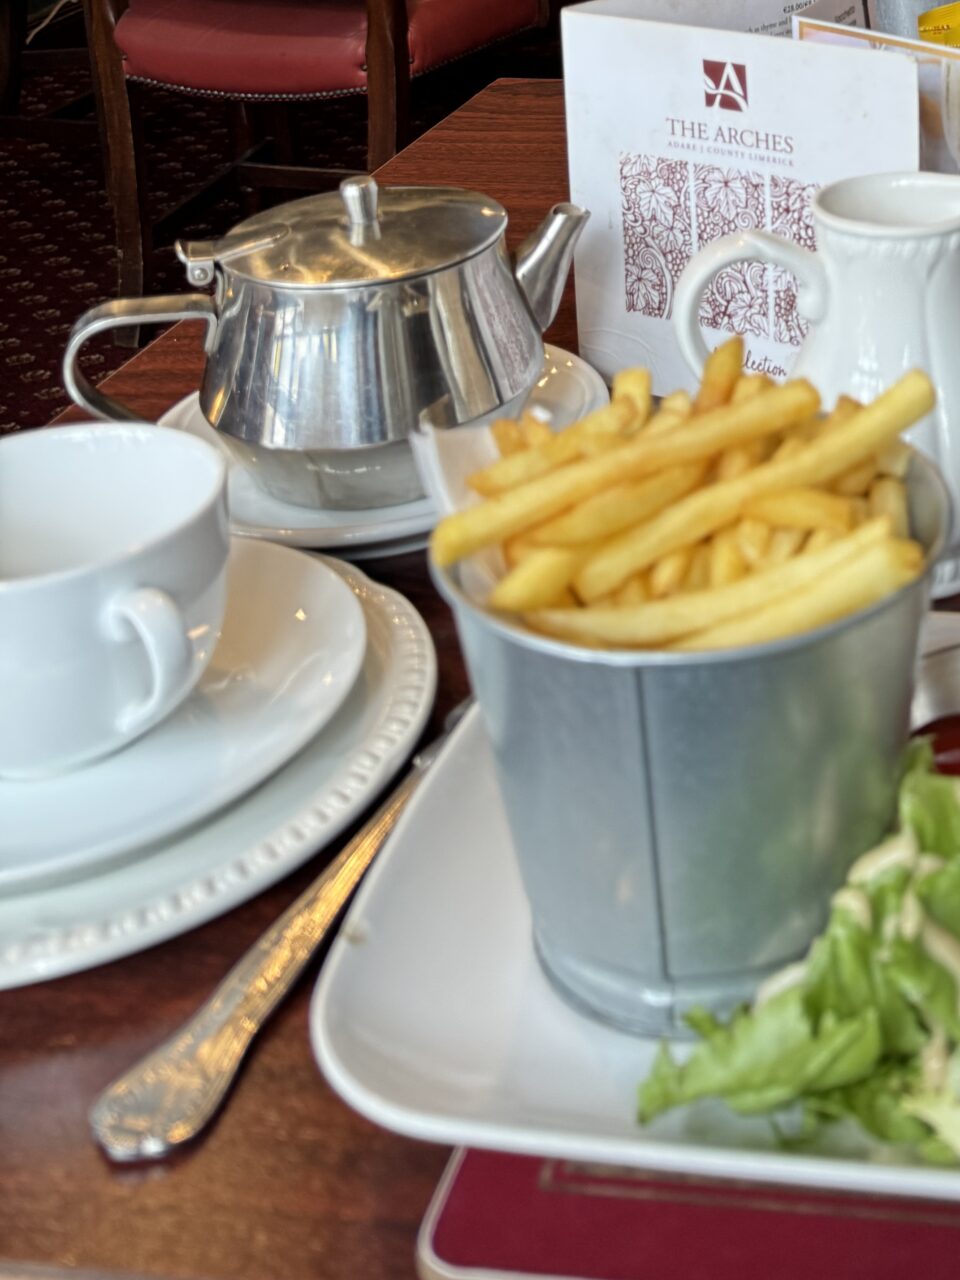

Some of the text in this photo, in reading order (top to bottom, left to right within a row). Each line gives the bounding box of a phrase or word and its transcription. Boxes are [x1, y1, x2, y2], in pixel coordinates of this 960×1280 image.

[666, 117, 795, 154] THE ARCHES
[668, 141, 795, 168] ADARE COUNTY LIMERICK
[742, 349, 787, 377] lection
